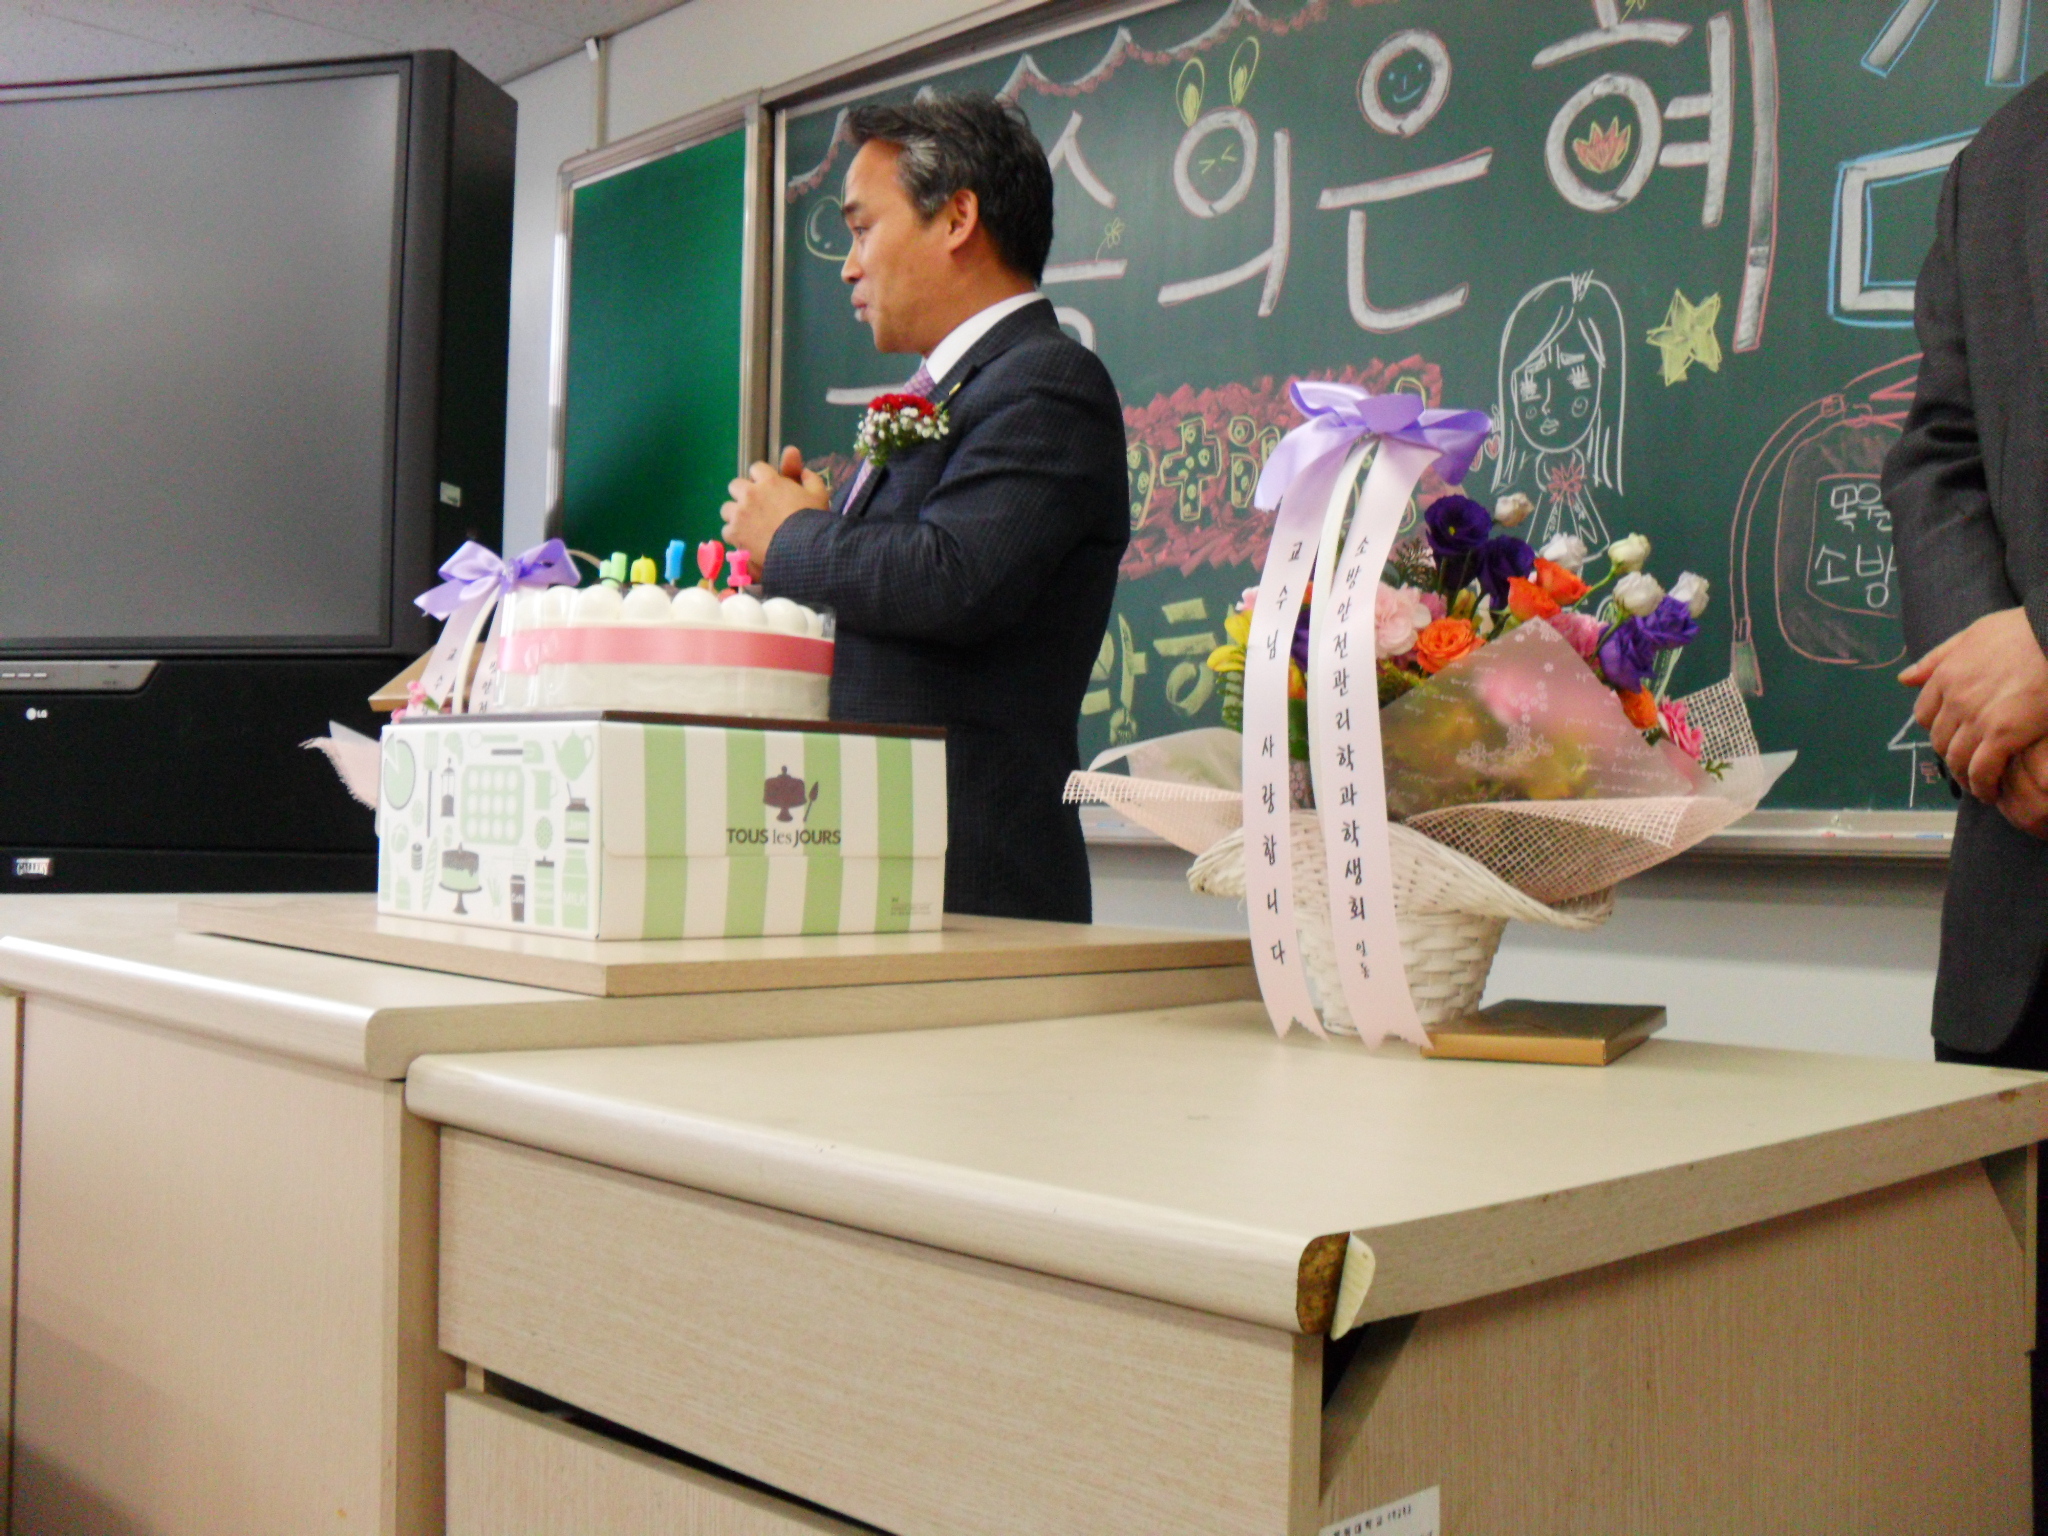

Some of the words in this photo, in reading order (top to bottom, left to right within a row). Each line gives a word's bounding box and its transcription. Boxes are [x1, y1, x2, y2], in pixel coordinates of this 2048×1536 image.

[1266, 541, 1303, 661] 교수님
[1814, 543, 1898, 609] 소방
[726, 828, 769, 844] TOUS
[772, 829, 792, 845] les
[793, 829, 841, 848] JOURS
[1261, 734, 1286, 965] 사랑합니다
